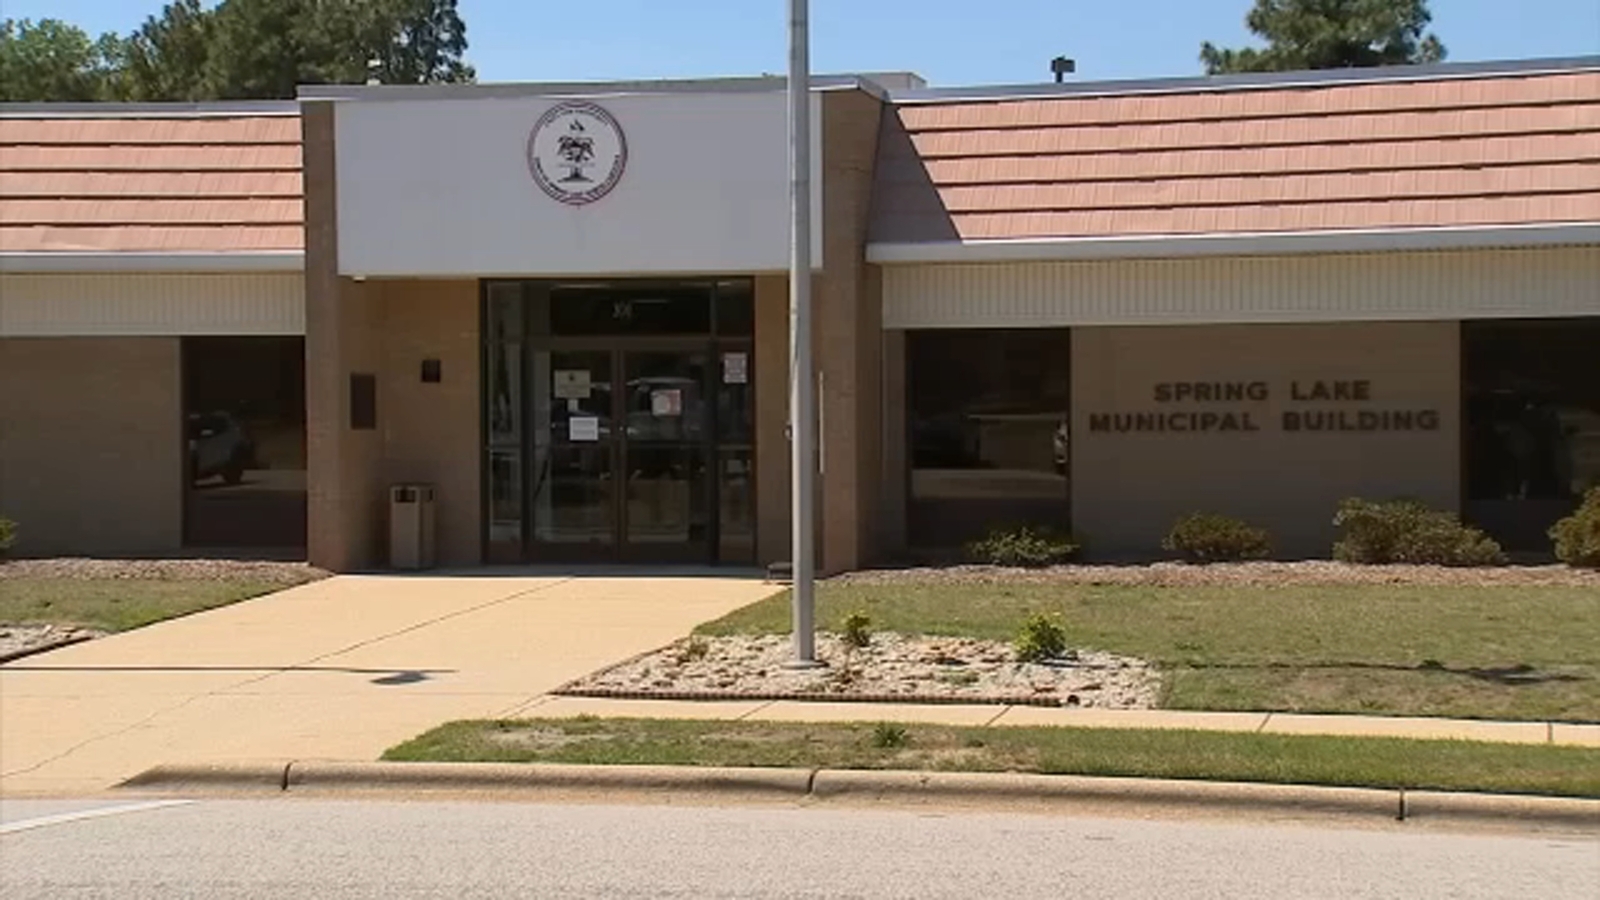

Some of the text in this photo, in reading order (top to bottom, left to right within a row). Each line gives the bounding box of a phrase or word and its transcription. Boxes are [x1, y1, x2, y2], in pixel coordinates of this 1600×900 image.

[1153, 380, 1371, 402] SPRING LAKE
[1089, 410, 1440, 432] MUNICIPAL BUILDING
